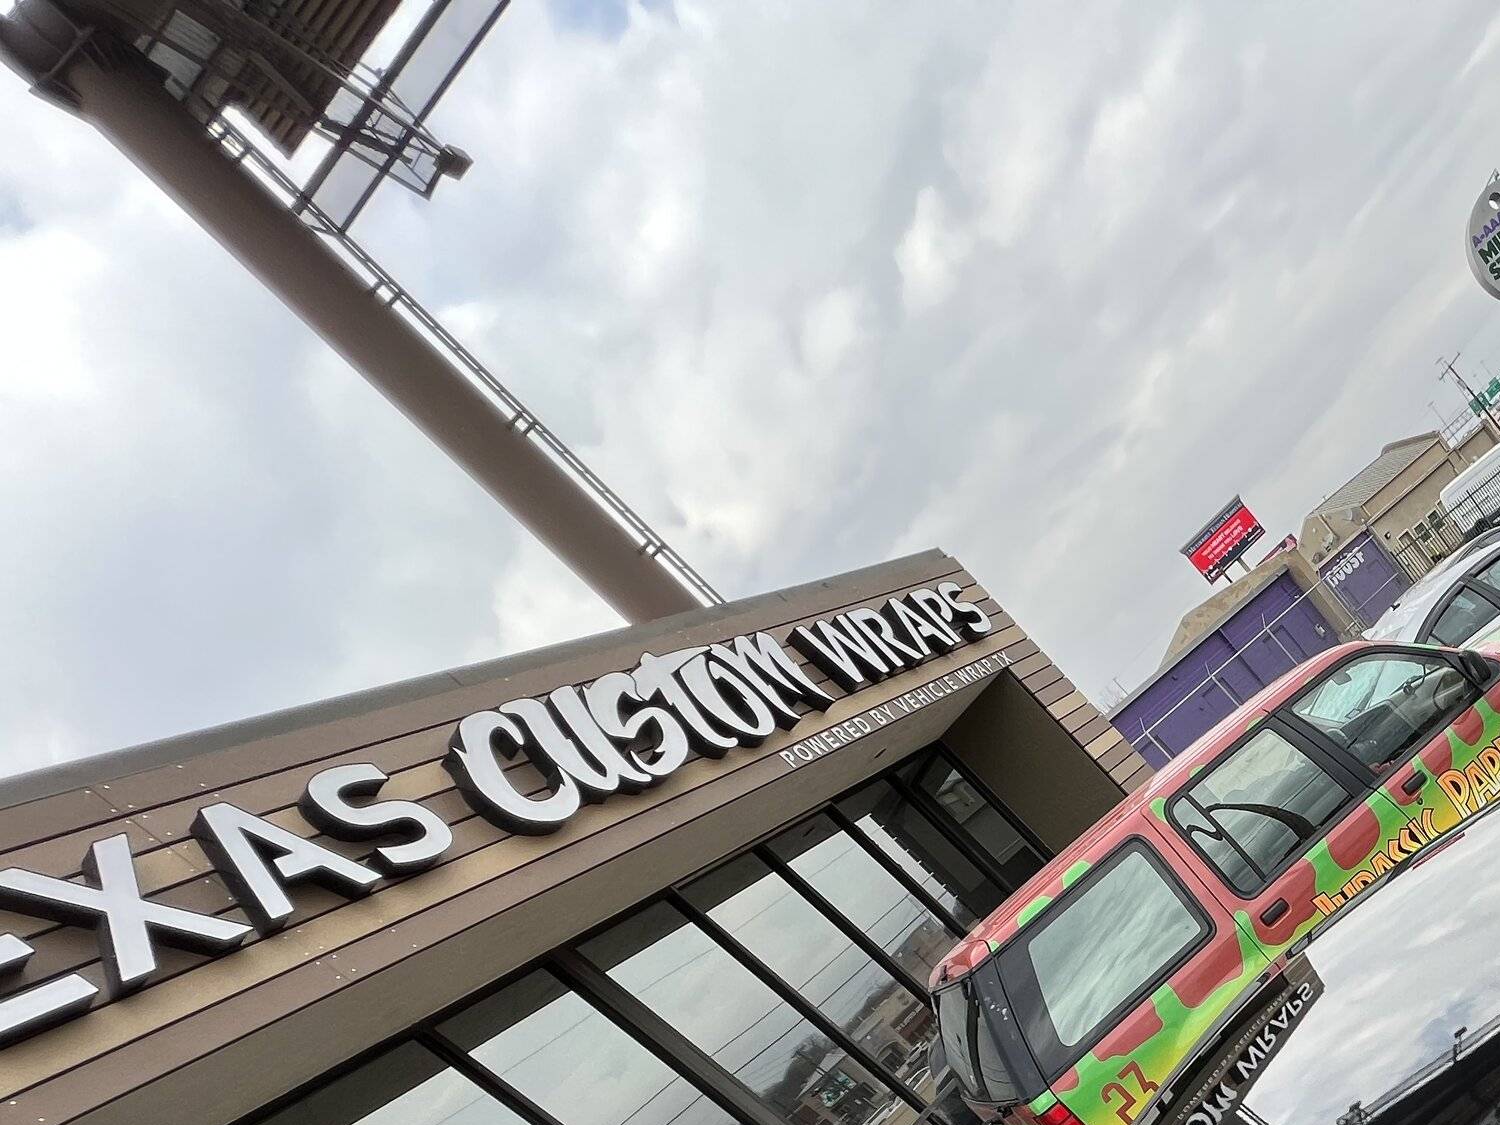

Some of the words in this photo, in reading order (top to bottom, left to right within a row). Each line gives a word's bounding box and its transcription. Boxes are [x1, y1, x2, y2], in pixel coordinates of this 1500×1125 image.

[446, 632, 835, 826] CUSTOM
[792, 582, 993, 685] WRAPS
[779, 717, 871, 768] POWERED
[869, 704, 896, 725] BY
[894, 675, 958, 713] VEHICLE
[955, 659, 994, 685] WRAP
[992, 650, 1014, 669] TX
